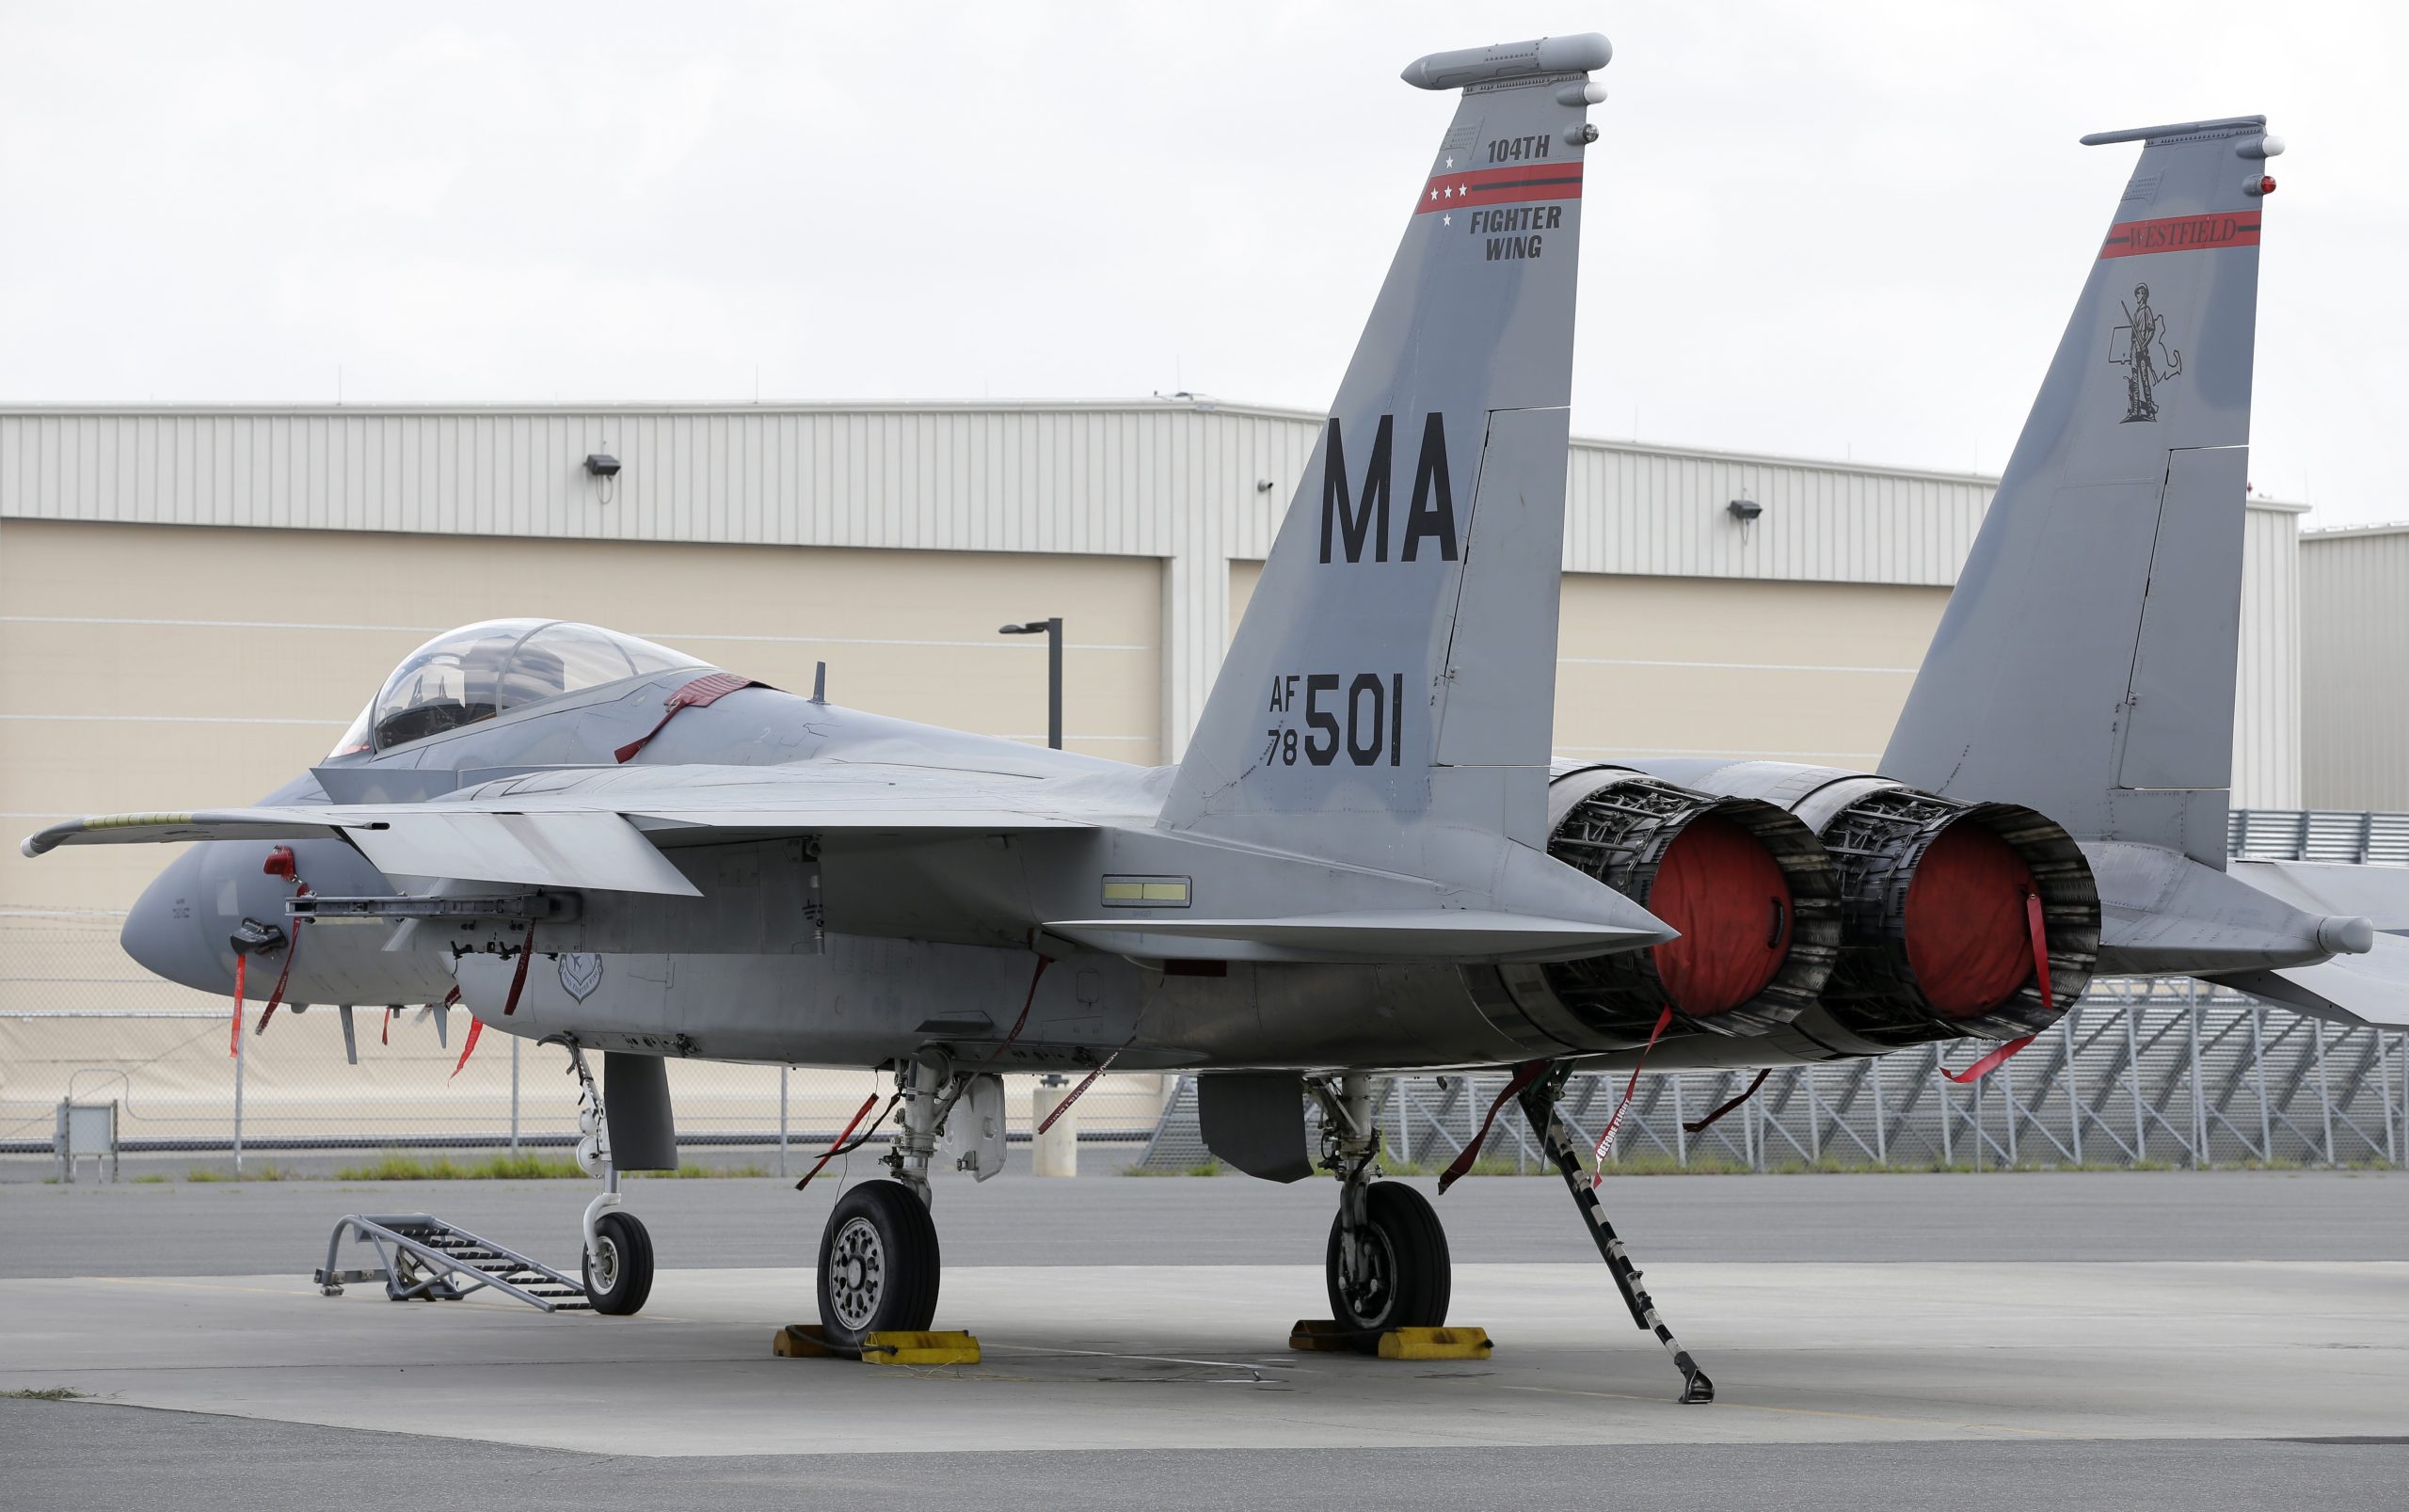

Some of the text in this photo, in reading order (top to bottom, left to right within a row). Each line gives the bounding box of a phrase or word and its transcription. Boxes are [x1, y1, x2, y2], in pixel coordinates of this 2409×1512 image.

[1489, 135, 1551, 163] 104TH
[1470, 205, 1562, 234] FIGHTER
[2130, 218, 2237, 249] WESTFIELD
[1486, 235, 1542, 261] WING
[1319, 411, 1459, 565] MA
[1268, 675, 1300, 713] AF
[1304, 672, 1403, 767] 501
[1266, 728, 1299, 767] 78
[1597, 1097, 1631, 1157] BEFORE FLIGHT
